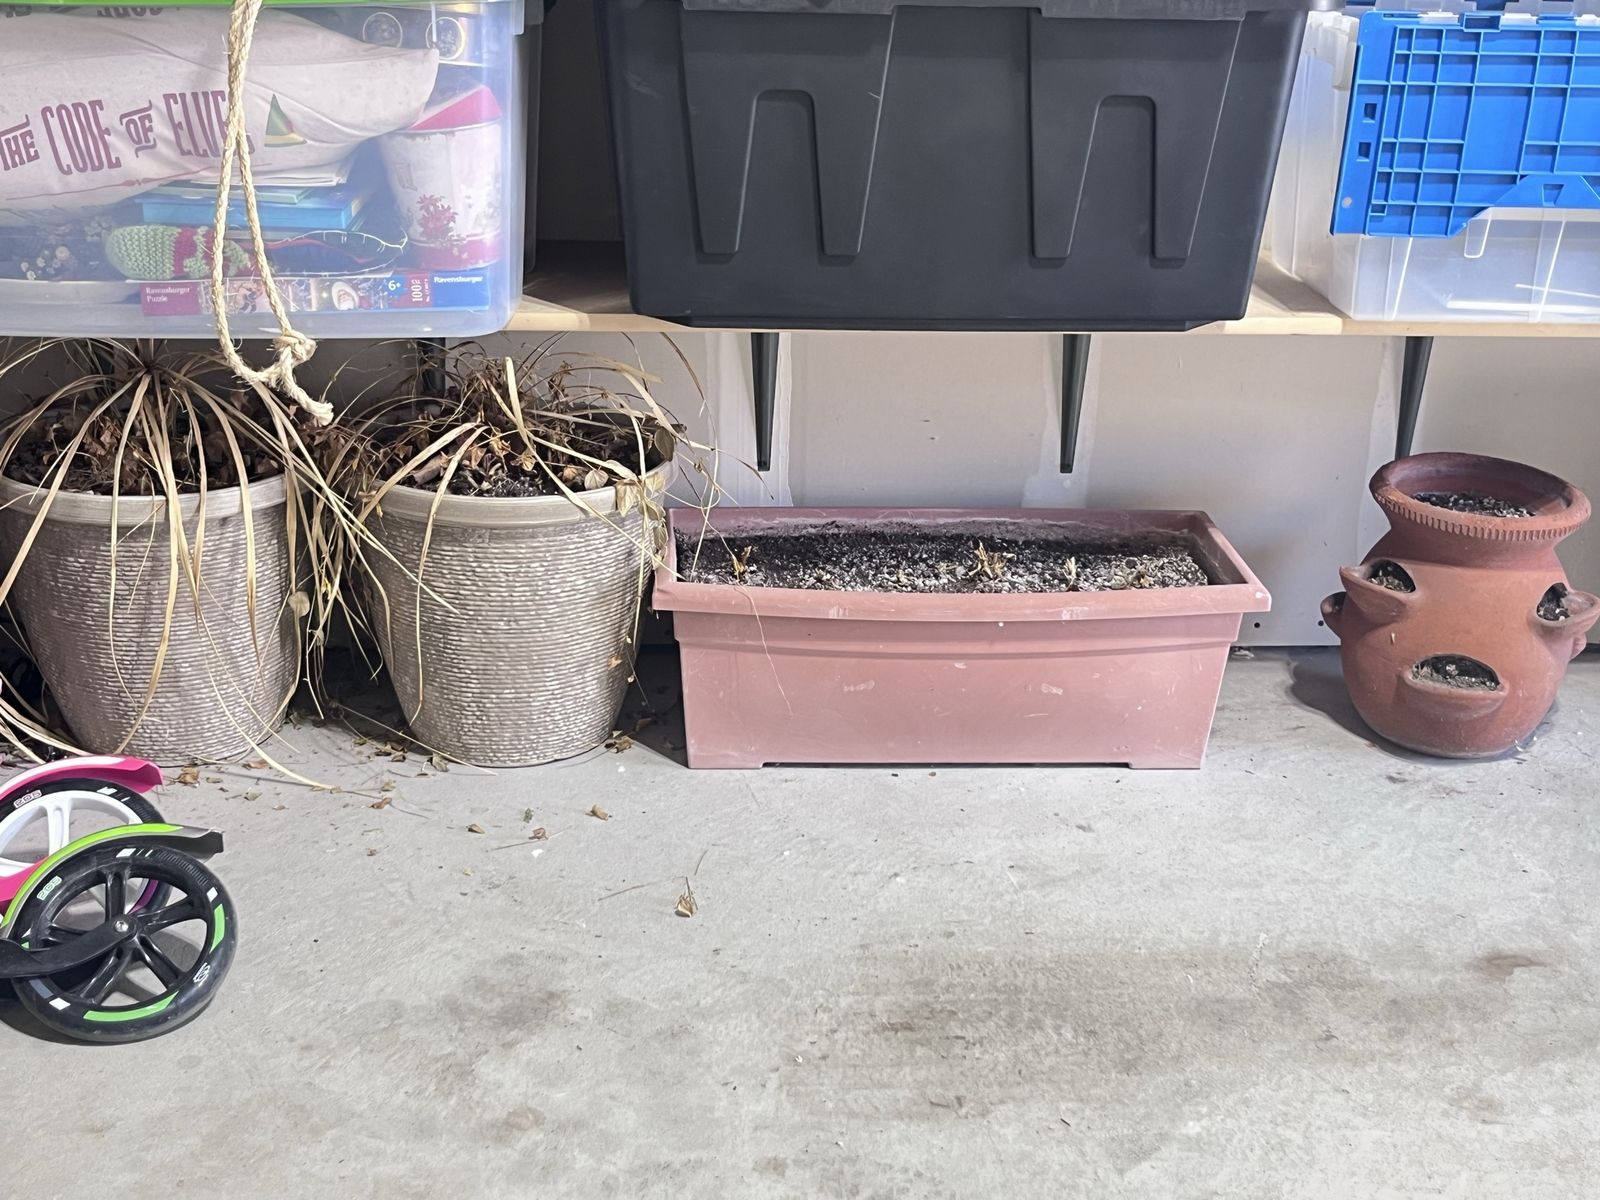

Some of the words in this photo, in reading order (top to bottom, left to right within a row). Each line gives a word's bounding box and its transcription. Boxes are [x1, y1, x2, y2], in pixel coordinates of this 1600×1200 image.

[41, 100, 122, 175] CODE
[120, 104, 156, 151] OF
[163, 90, 255, 157] ELVE
[434, 276, 484, 284] Ravensburger
[145, 287, 190, 295] Ravensburger
[147, 295, 168, 303] Puzzle
